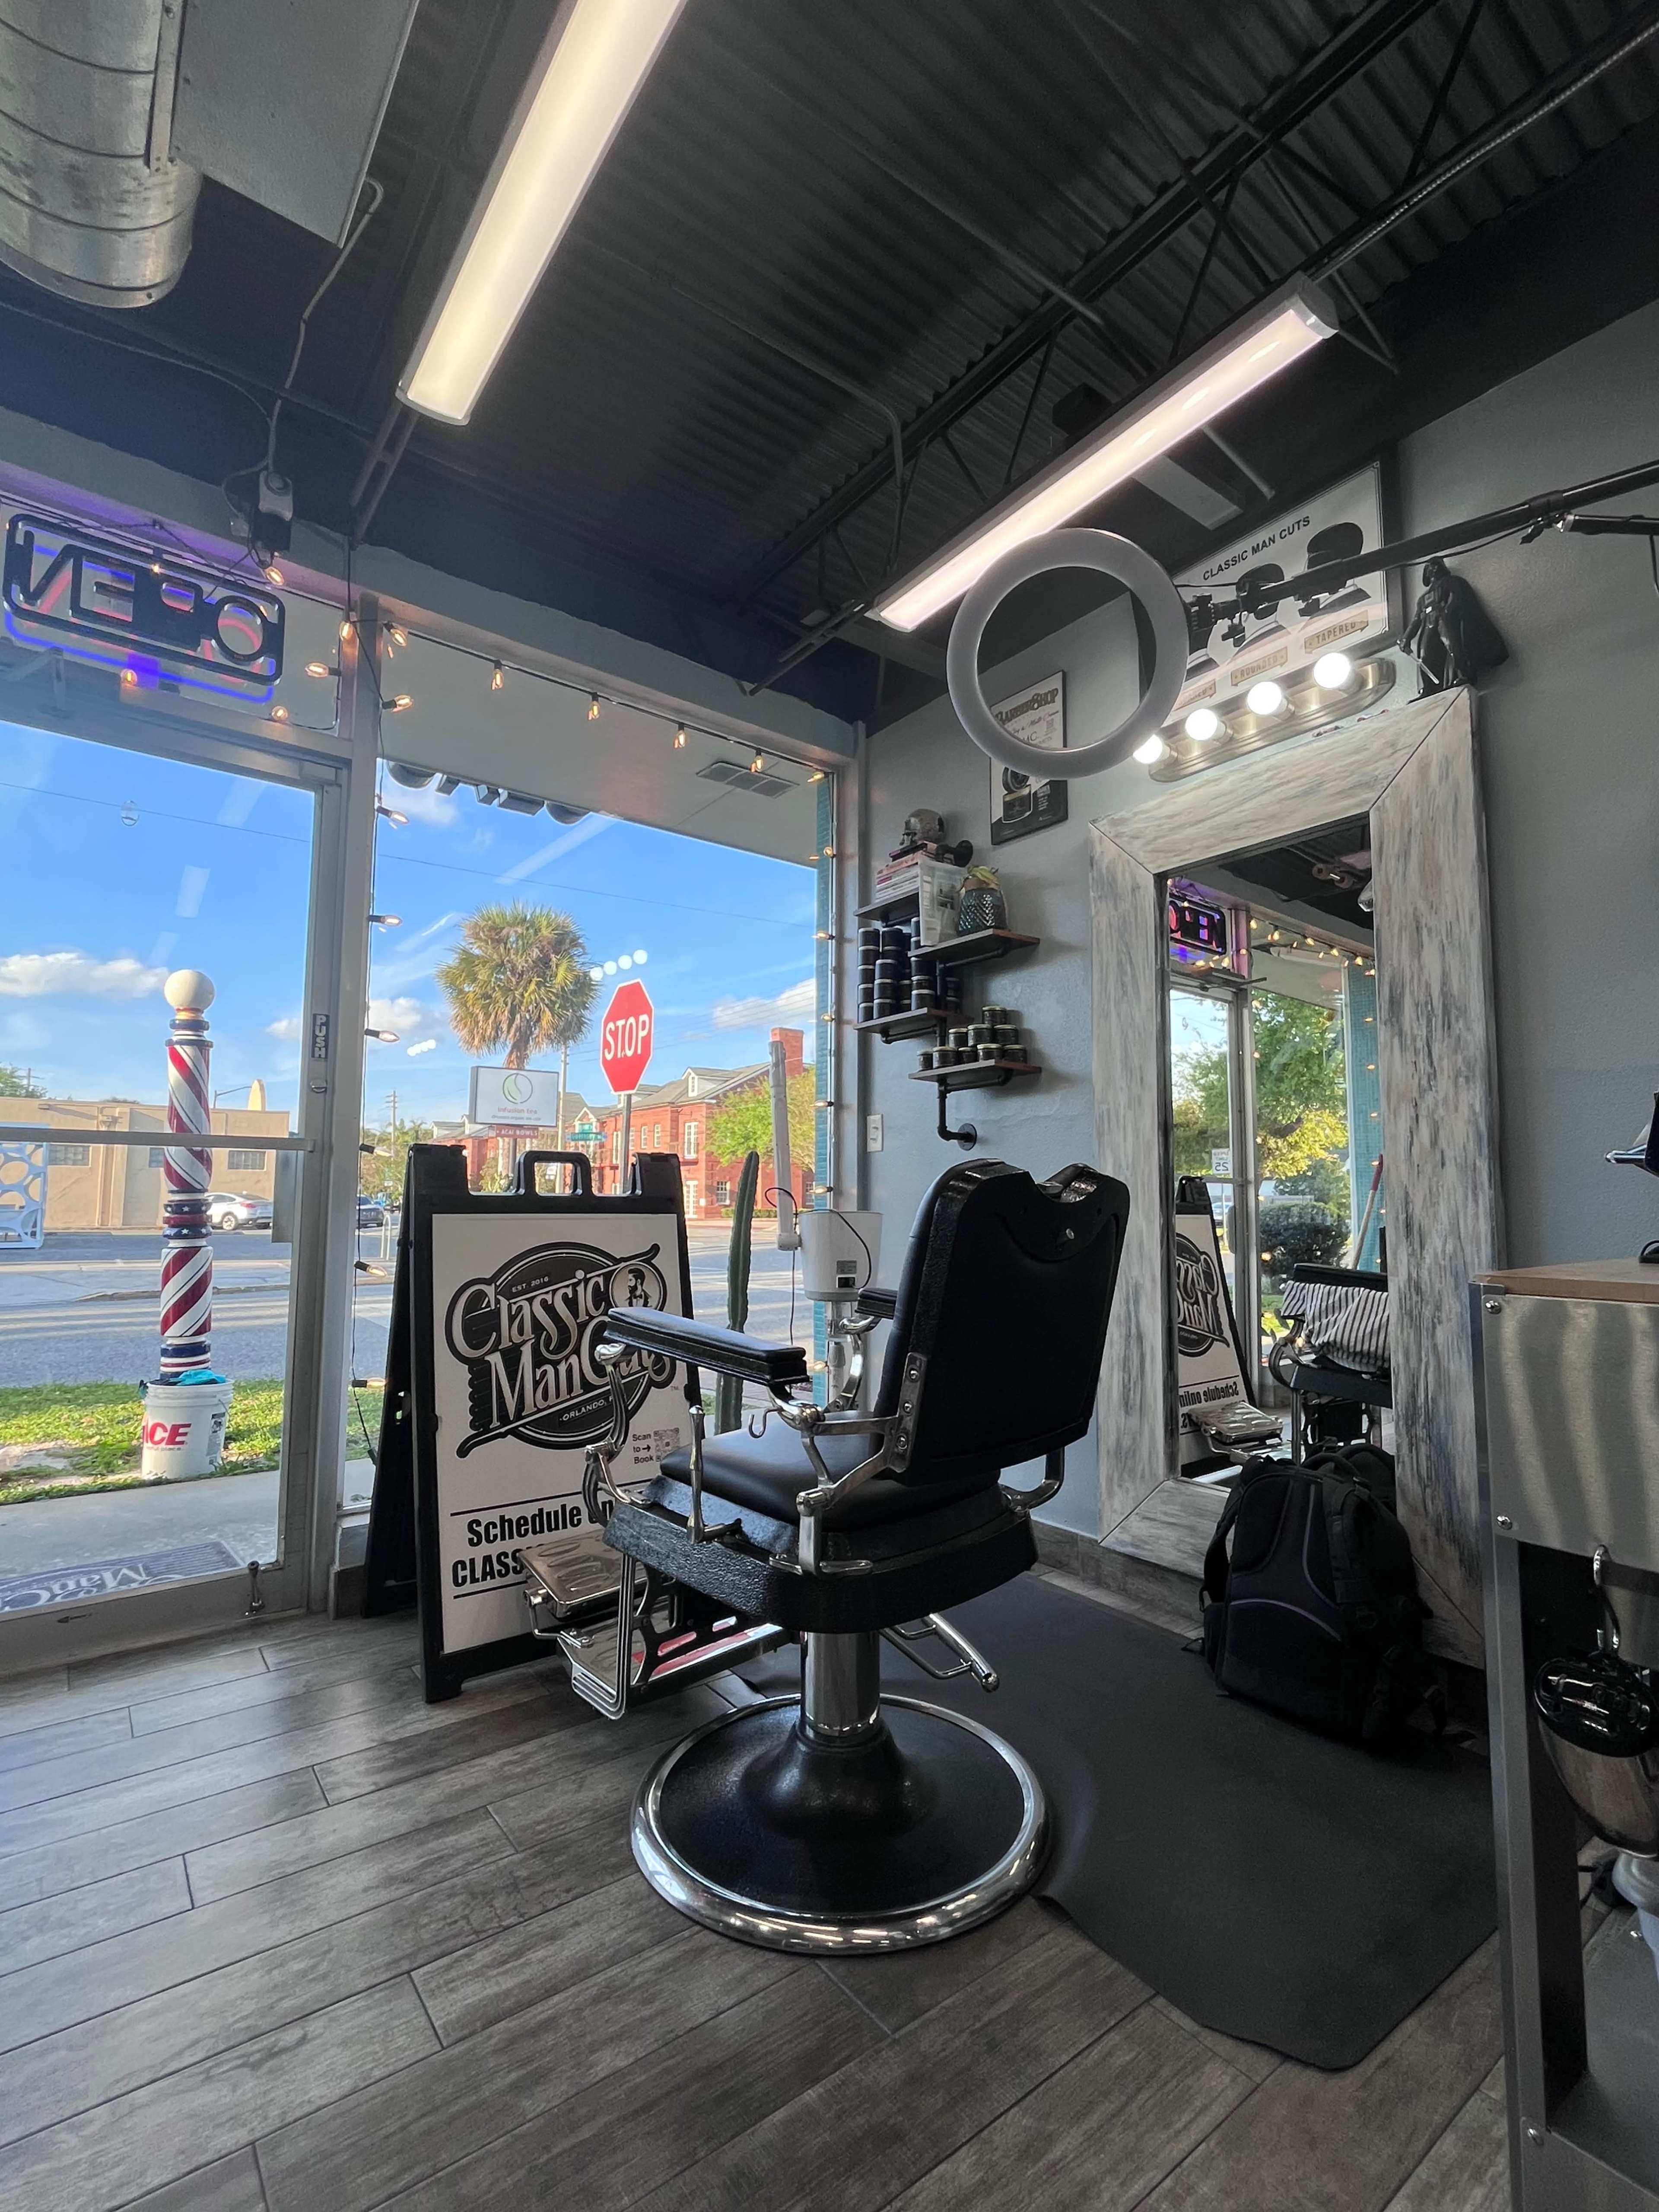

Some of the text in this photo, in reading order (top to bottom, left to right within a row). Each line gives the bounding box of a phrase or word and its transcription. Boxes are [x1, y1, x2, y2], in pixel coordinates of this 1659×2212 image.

[1203, 516, 1310, 581] CLASSIC MAN CUTS
[1316, 622, 1356, 644] TAPERED
[1239, 655, 1278, 678] ROUNDED
[314, 1015, 327, 1058] PUSH
[604, 1014, 648, 1061] STOP
[531, 1276, 549, 1286] 2016
[451, 1269, 605, 1360] Classic
[632, 1433, 651, 1442] Scan
[634, 1455, 654, 1464] Book
[467, 1503, 582, 1547] Schedule
